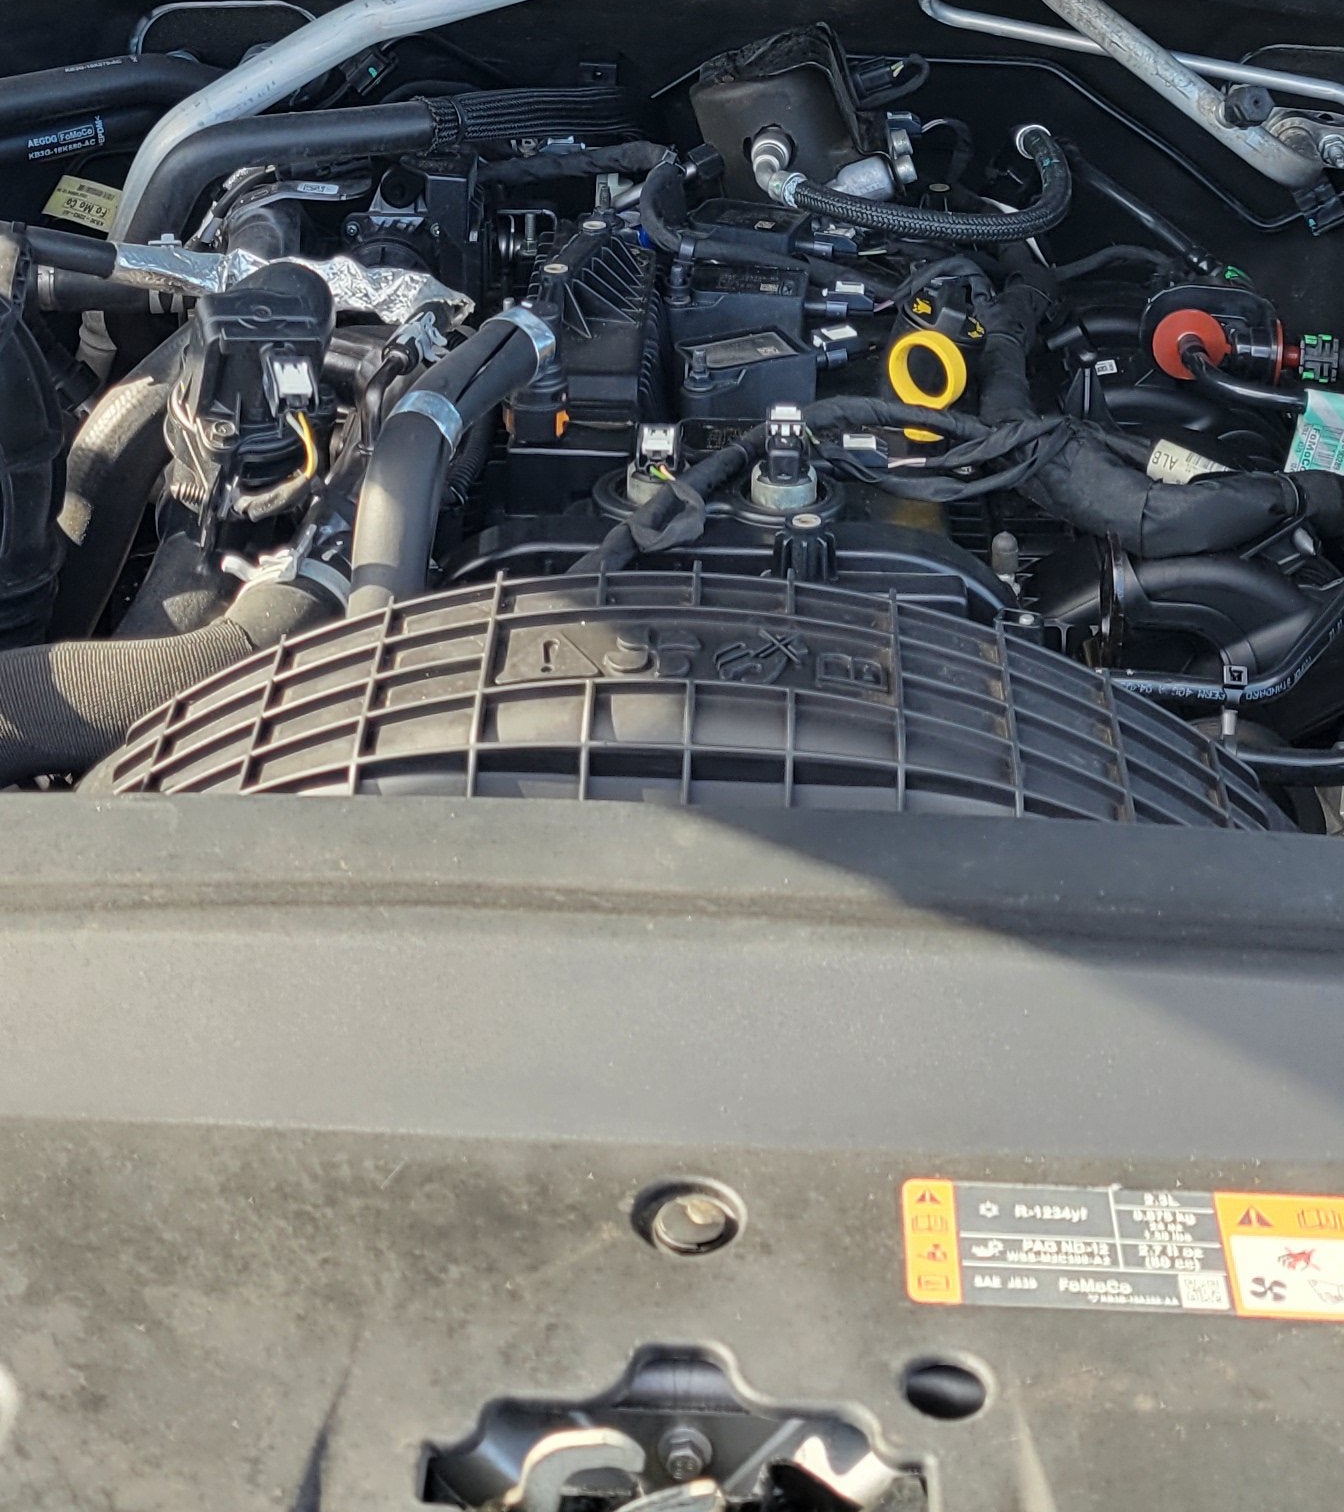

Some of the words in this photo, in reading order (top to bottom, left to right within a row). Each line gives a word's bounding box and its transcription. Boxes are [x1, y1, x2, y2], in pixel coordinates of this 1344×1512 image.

[59, 127, 93, 142] FoMoCo
[1014, 1204, 1089, 1223] R-1234yf
[973, 1274, 1003, 1289] SAE
[1058, 1276, 1133, 1295] FoMoCo
